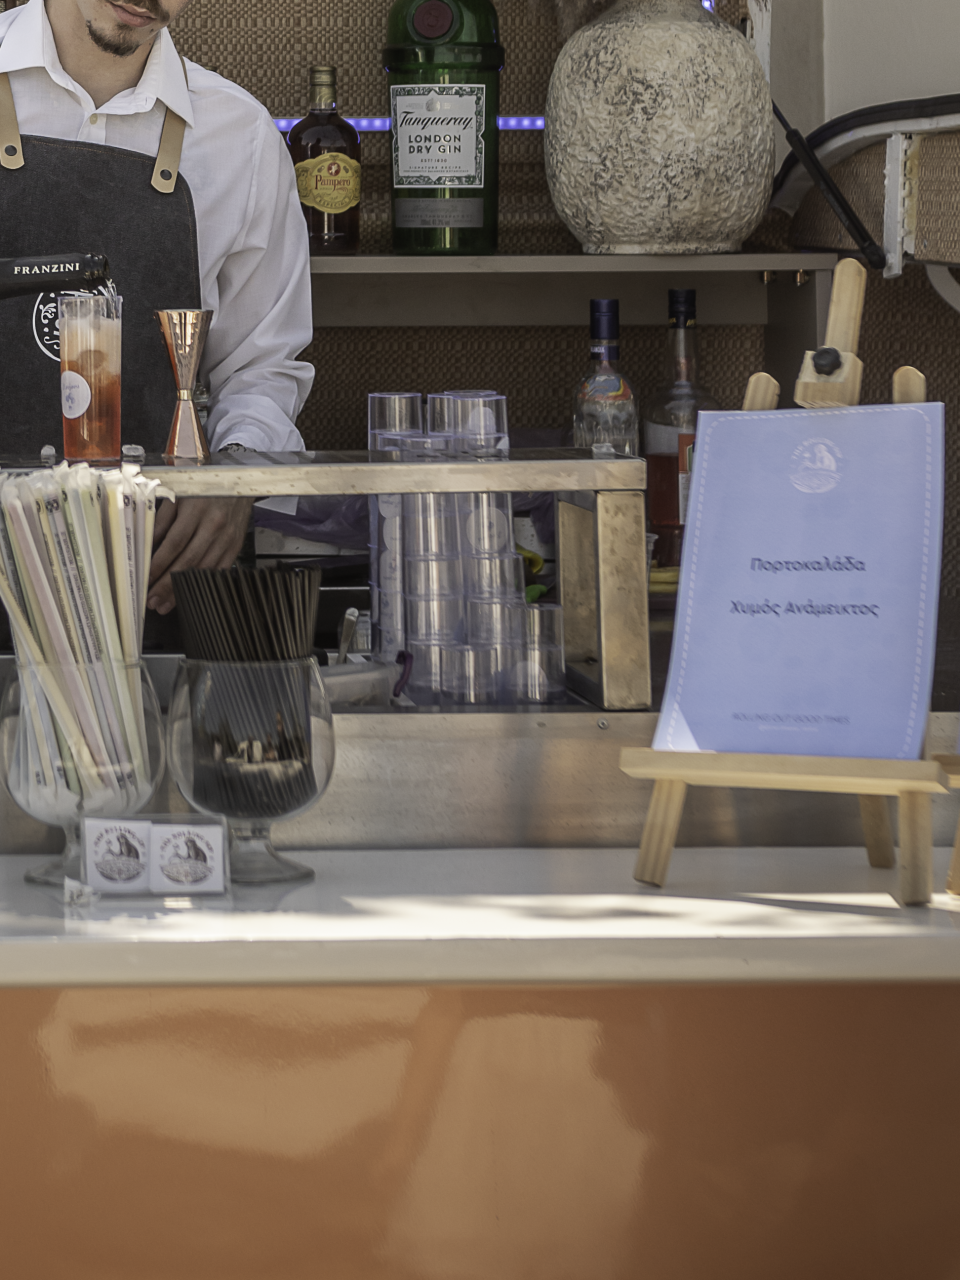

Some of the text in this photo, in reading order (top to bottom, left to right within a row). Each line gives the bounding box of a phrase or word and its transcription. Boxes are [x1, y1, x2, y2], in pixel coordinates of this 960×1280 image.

[400, 111, 473, 130] Tanqueray
[408, 134, 461, 144] LONDON
[408, 144, 461, 154] DRY GIN
[314, 174, 351, 193] Pampero
[14, 262, 80, 275] FRANZINI
[750, 555, 867, 574] Πορτοκαλάδα
[730, 598, 881, 618] Χυμός Ανάμεικτος
